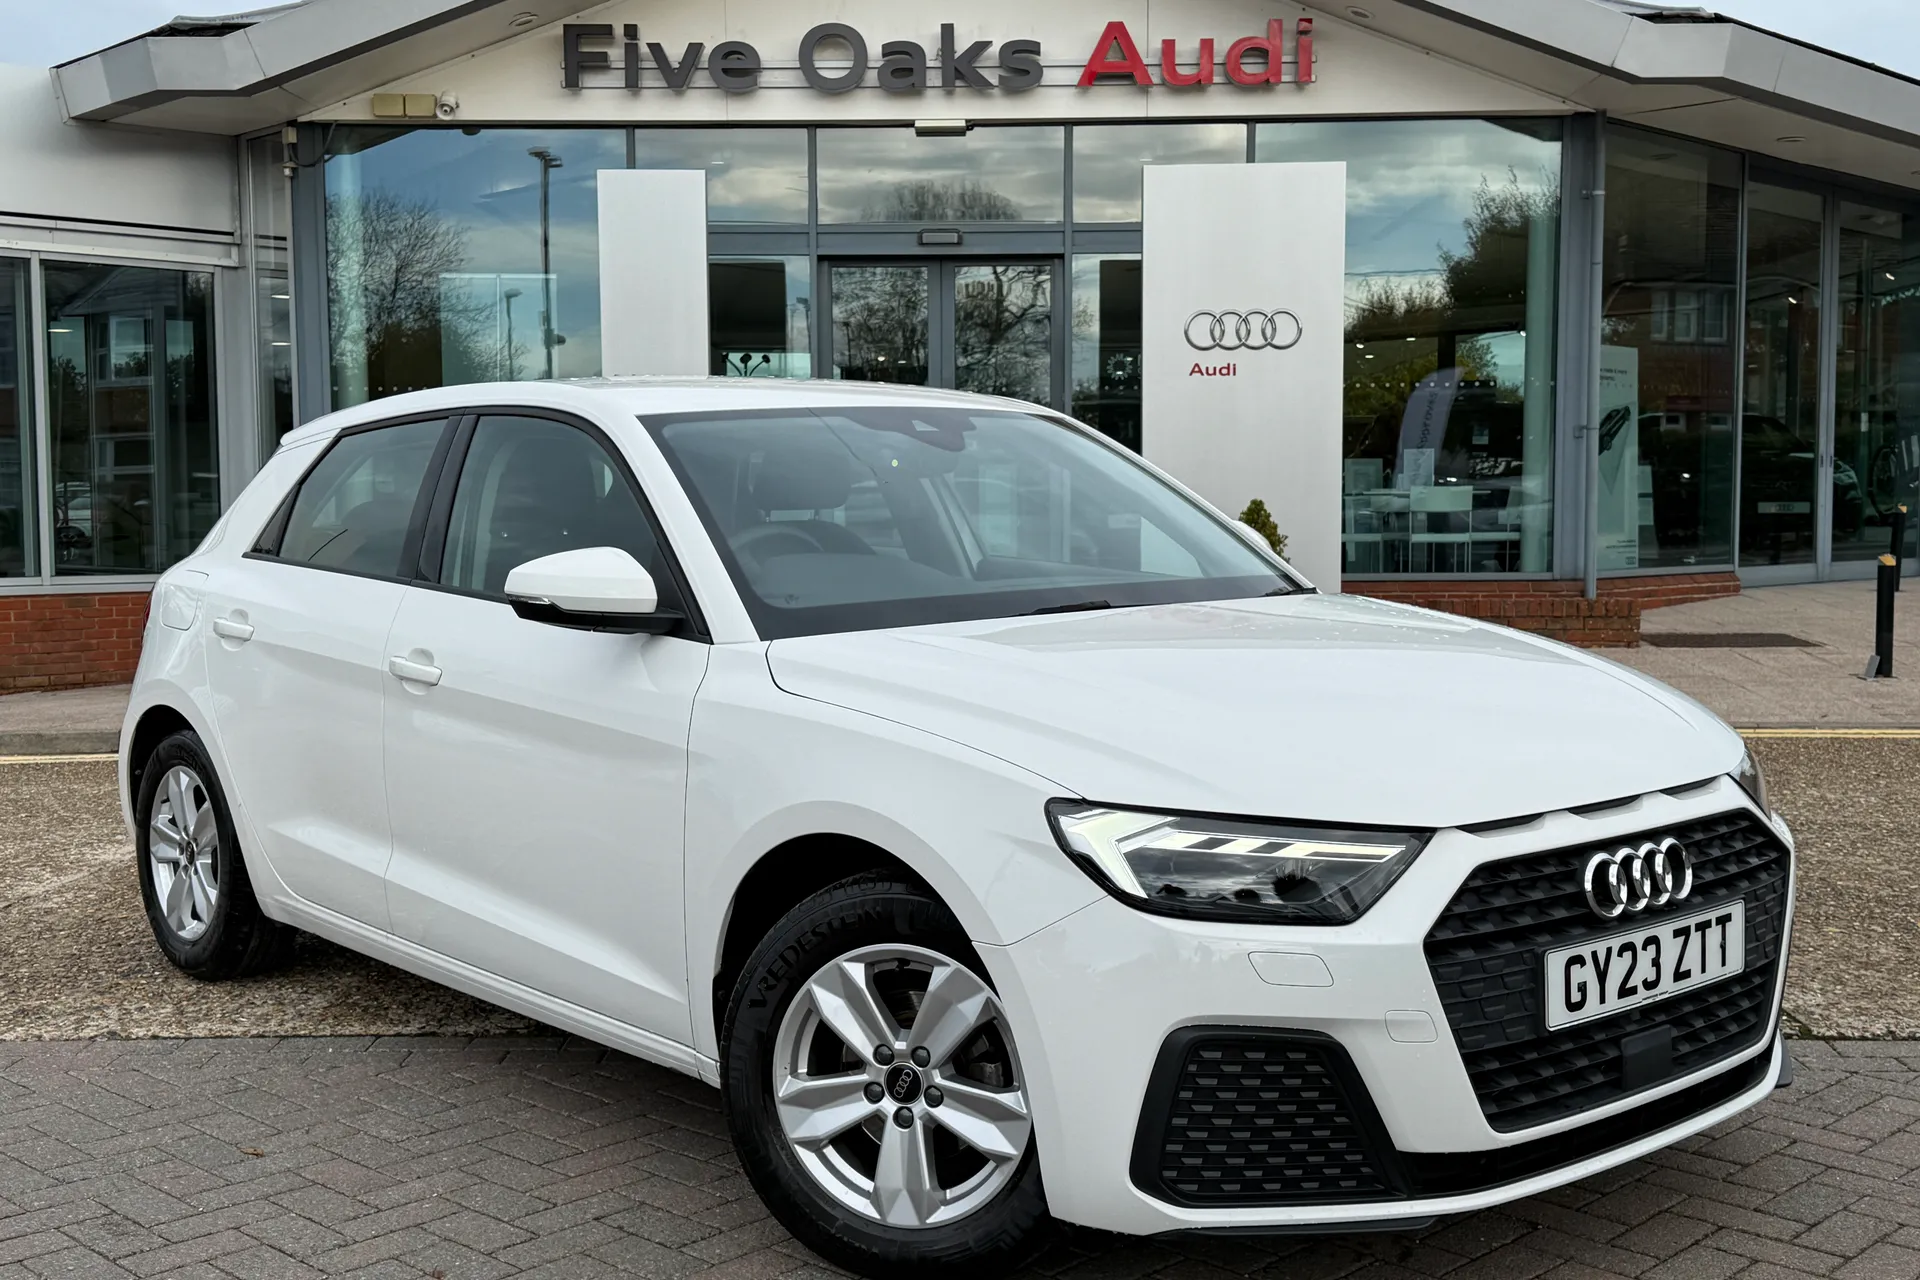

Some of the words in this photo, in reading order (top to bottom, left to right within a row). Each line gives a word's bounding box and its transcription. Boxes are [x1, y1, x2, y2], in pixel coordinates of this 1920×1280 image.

[562, 23, 762, 92] Five
[799, 22, 1043, 92] Oaks
[1075, 18, 1313, 89] Audi
[1189, 362, 1237, 376] Audi
[748, 906, 882, 1009] VREDESTEIN
[1564, 934, 1661, 1013] GY23
[1672, 912, 1732, 983] ZTT
